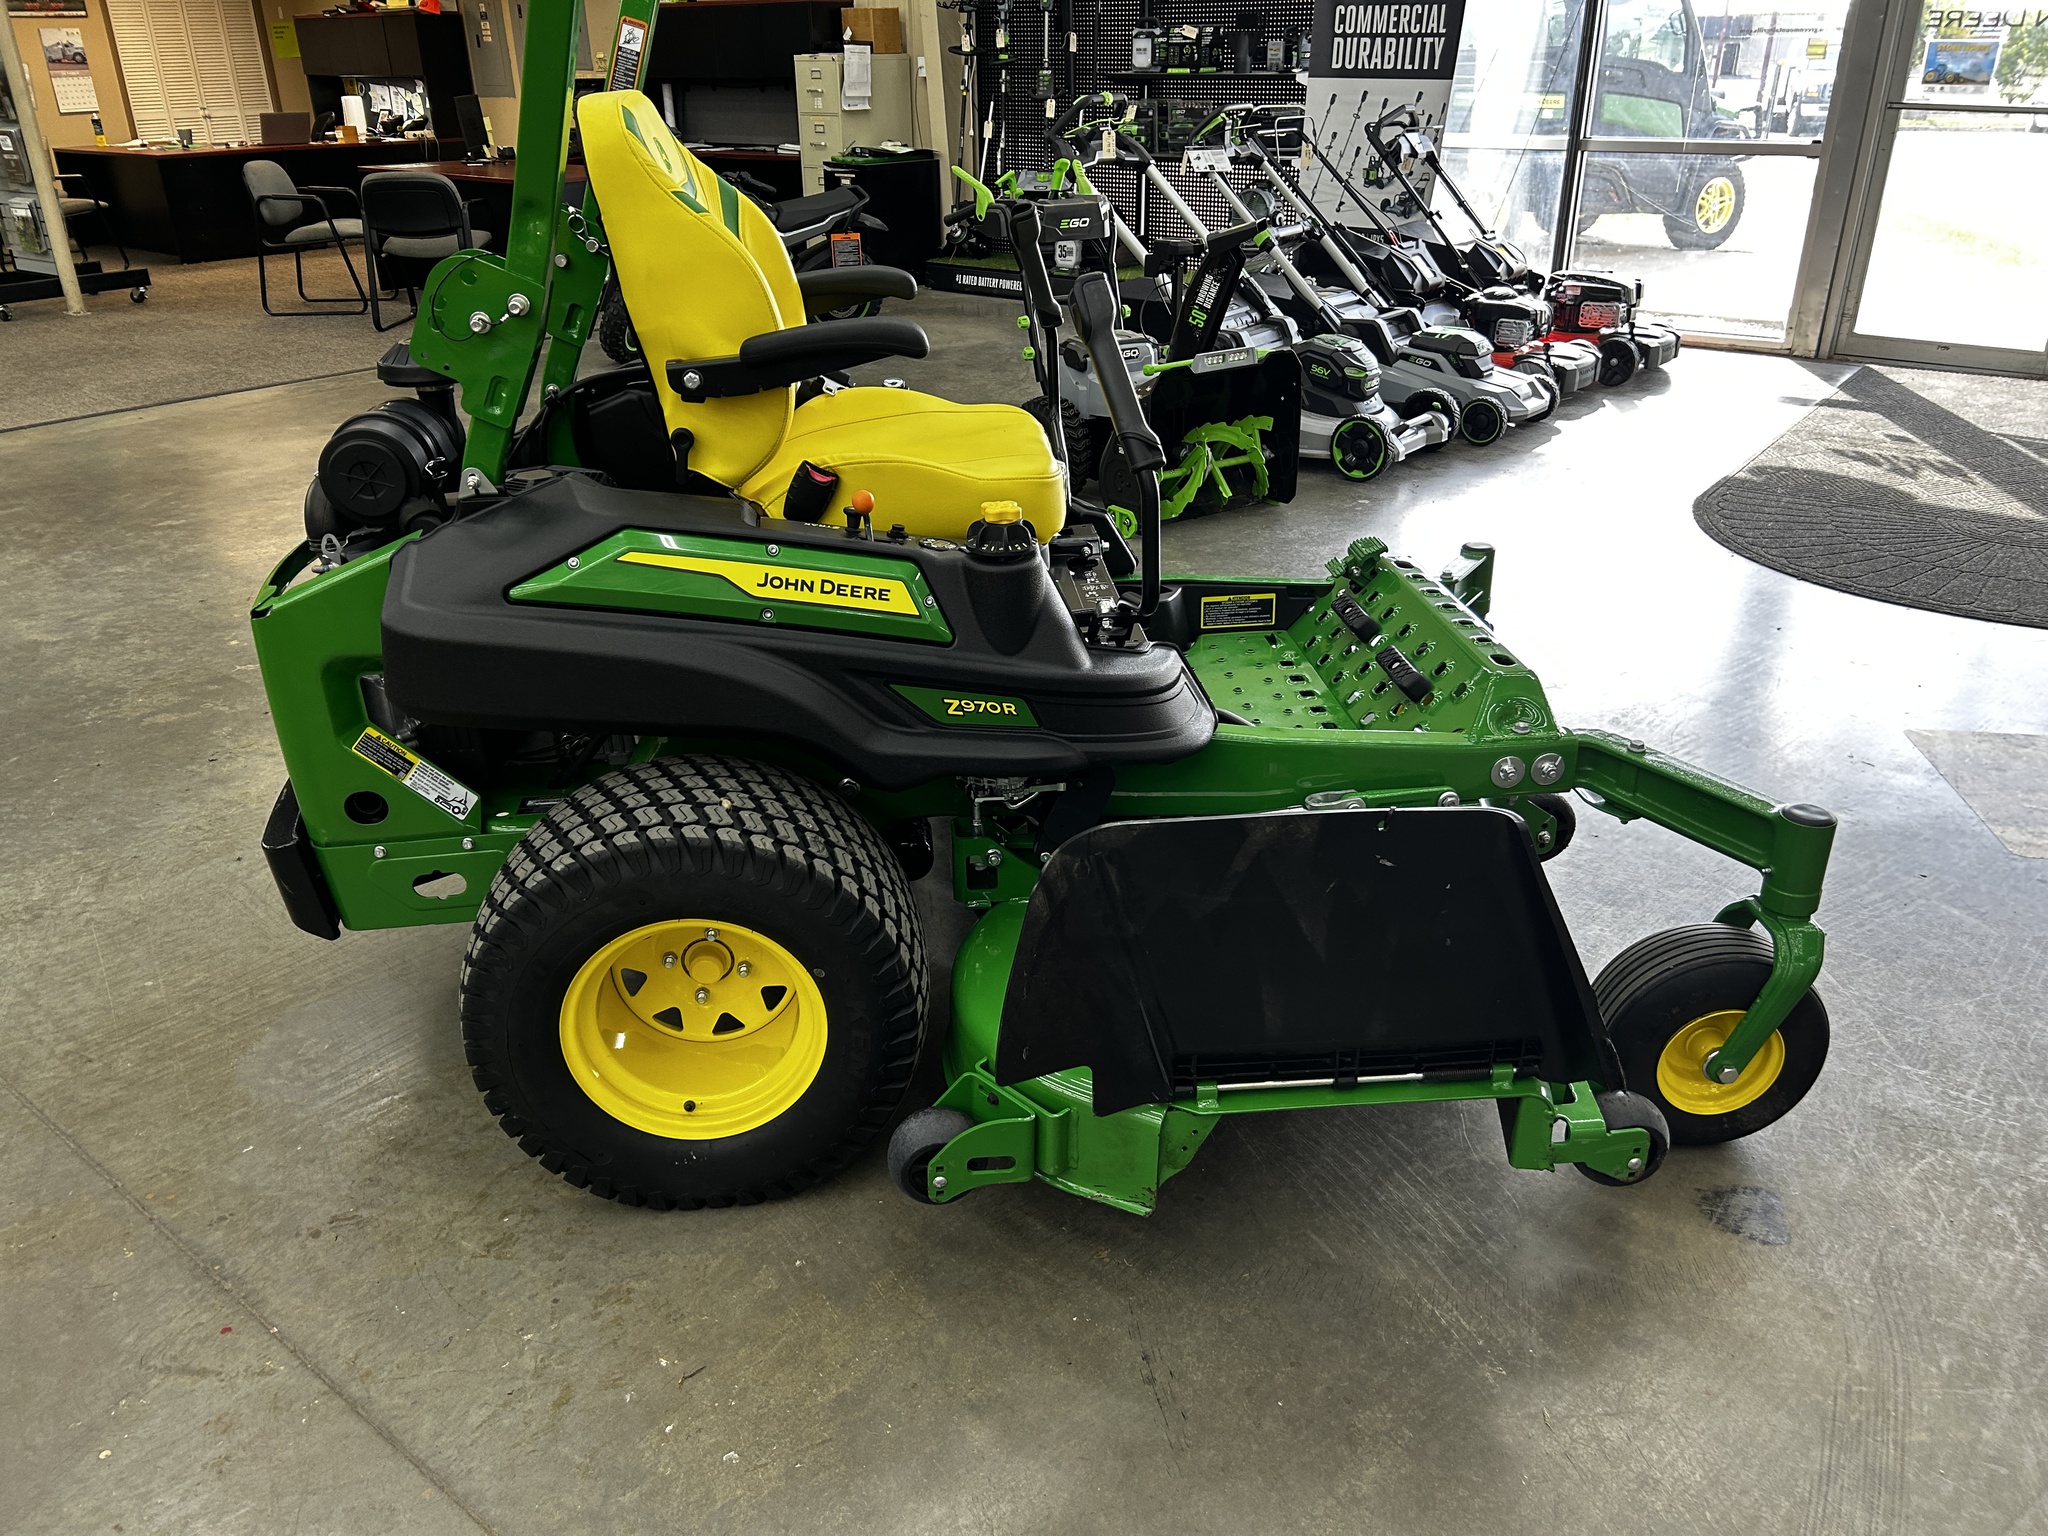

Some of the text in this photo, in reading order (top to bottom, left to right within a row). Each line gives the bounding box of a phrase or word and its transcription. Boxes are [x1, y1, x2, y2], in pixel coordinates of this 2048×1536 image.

[1334, 4, 1446, 34] COMMERCIAL
[1331, 37, 1446, 70] DURABILITY
[1060, 217, 1090, 229] EGO
[1058, 244, 1067, 259] 35
[962, 275, 978, 286] RATED
[978, 276, 999, 288] BATTERY
[1195, 273, 1214, 306] THROWING
[1203, 280, 1221, 309] DISTANCE
[1310, 363, 1331, 376] 56V
[1408, 355, 1432, 367] EGO
[756, 572, 891, 602] JOHN DEERE
[943, 698, 1018, 716] Z970R
[381, 737, 407, 758] CAUTION
